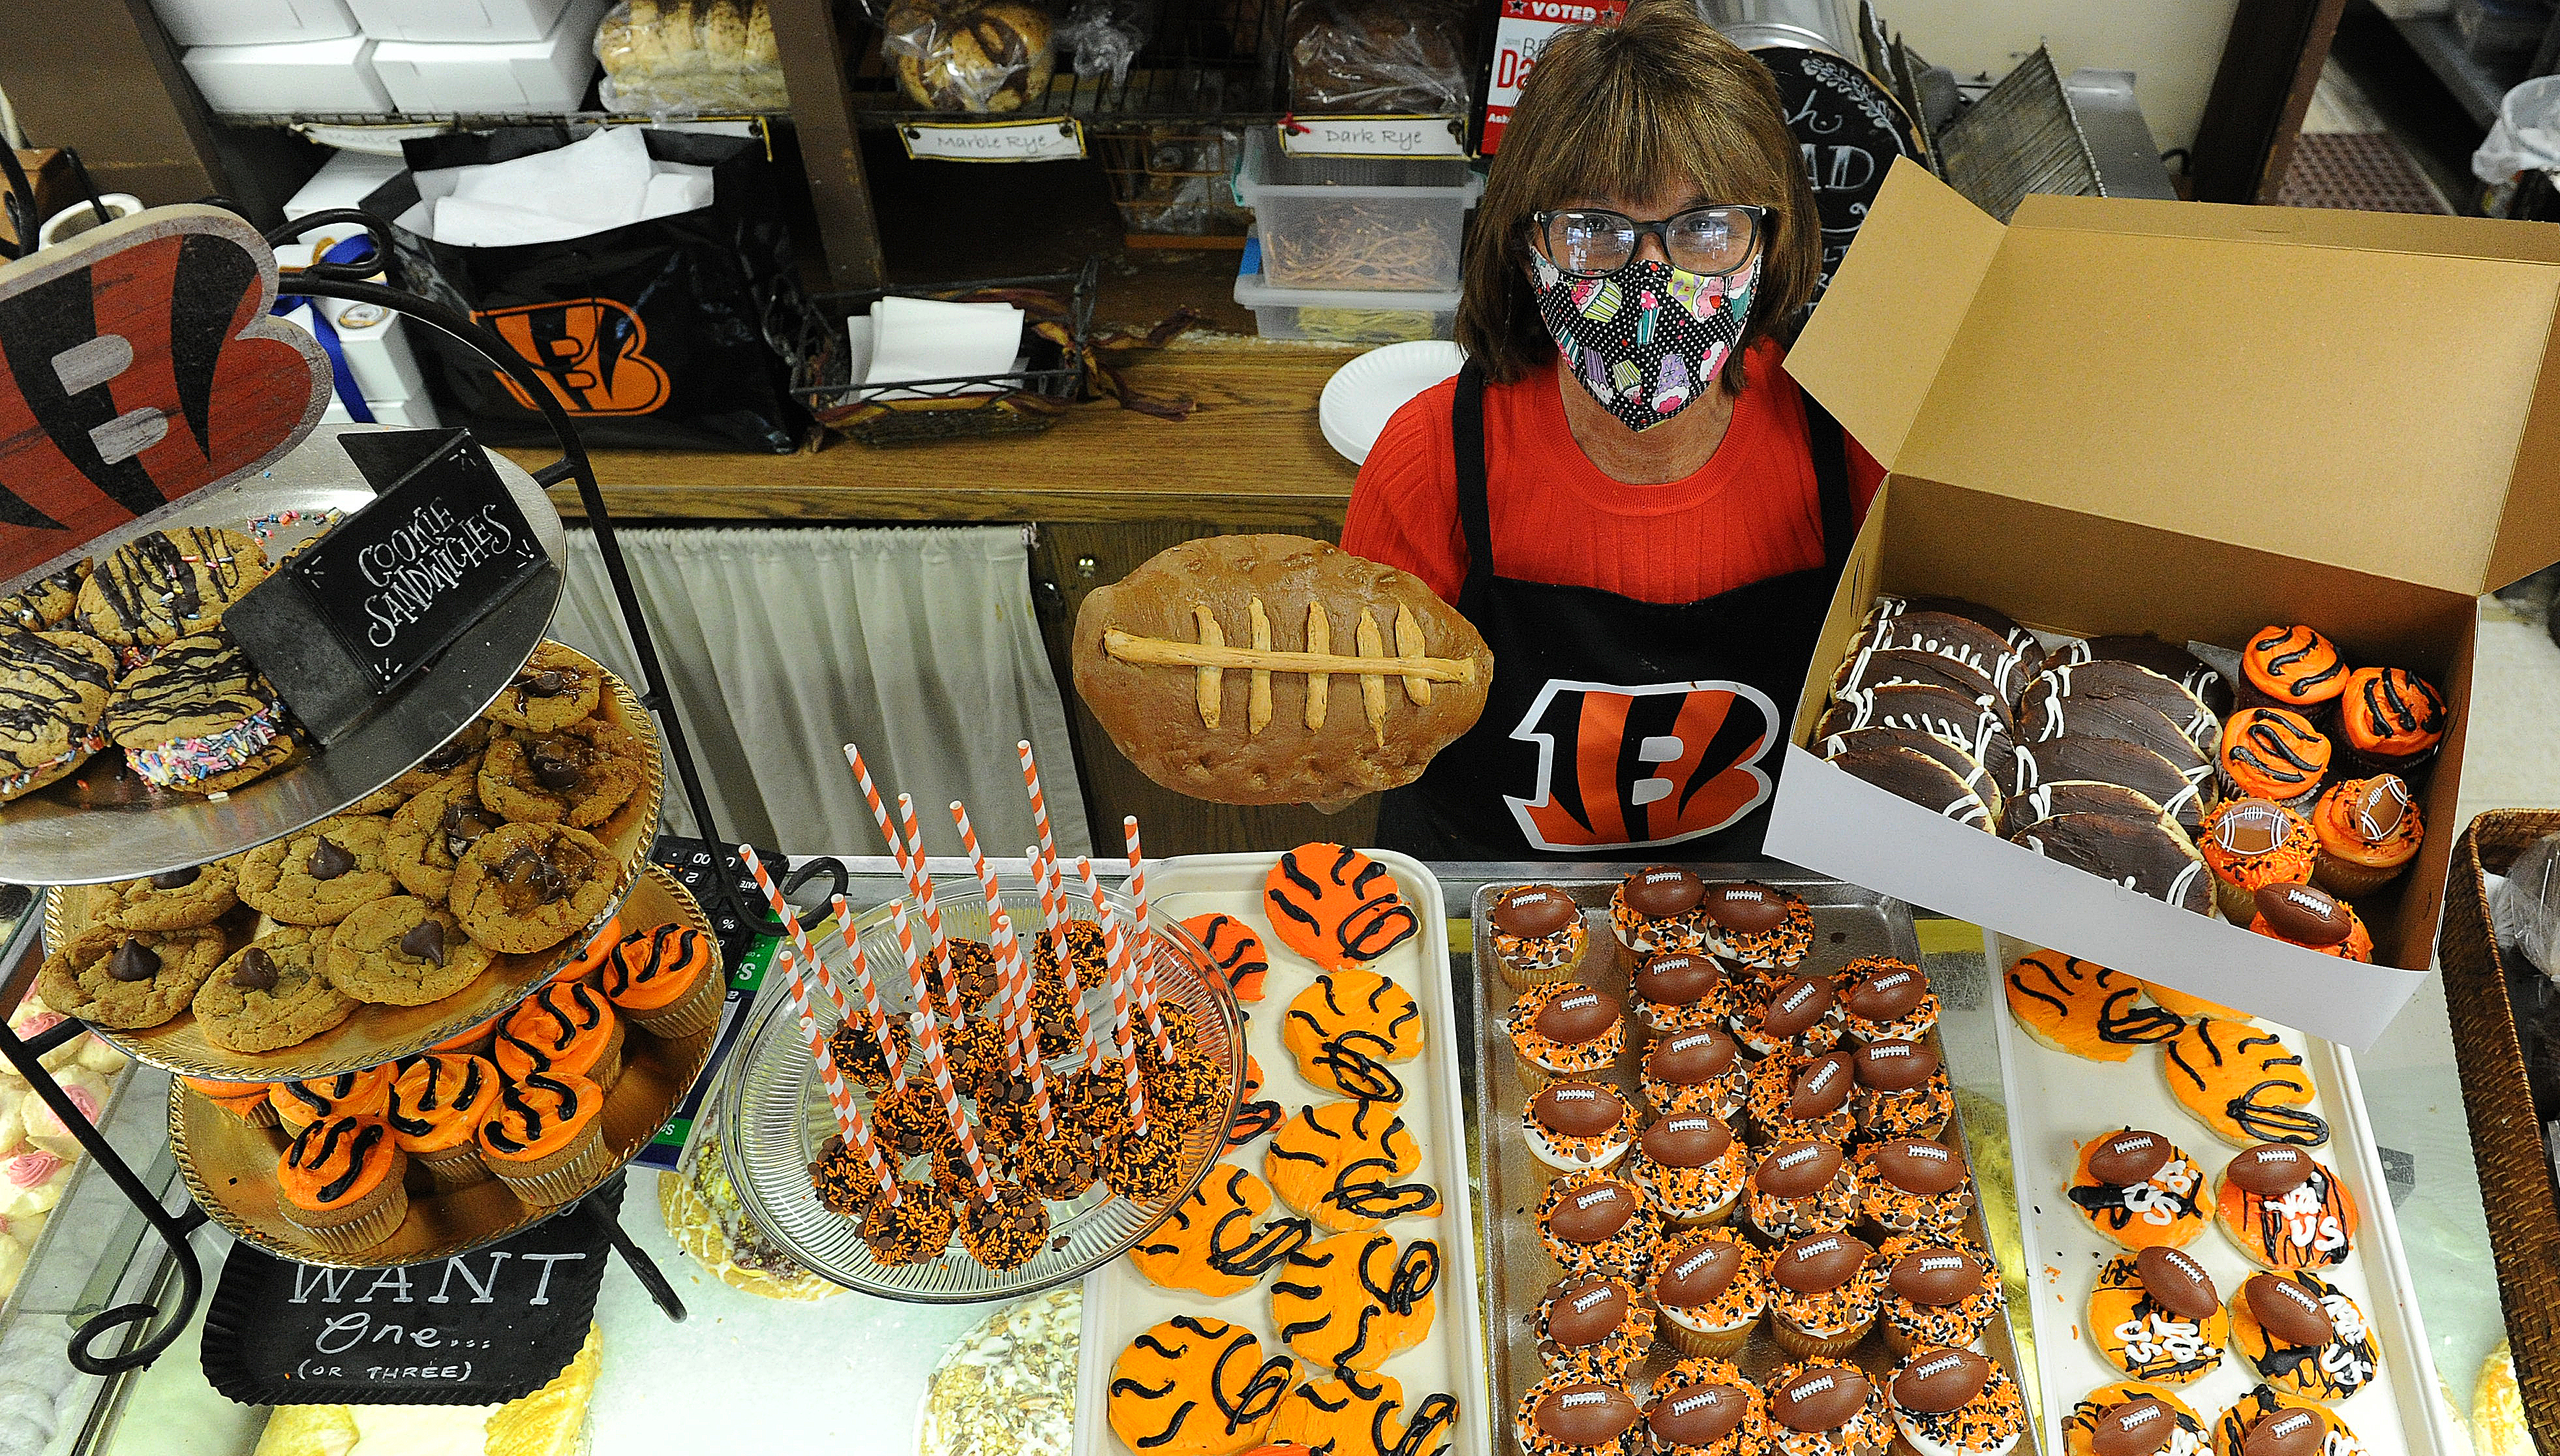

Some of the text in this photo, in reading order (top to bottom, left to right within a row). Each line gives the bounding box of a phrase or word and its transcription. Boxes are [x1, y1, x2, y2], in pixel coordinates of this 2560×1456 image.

[1531, 1, 1597, 22] VOTED
[937, 134, 1046, 154] Marble Rye
[1325, 129, 1424, 152] Dark Rye
[357, 496, 459, 588] COOKIE
[363, 503, 511, 648] SANDWICHES
[739, 880, 758, 892] RATE
[286, 1251, 586, 1307] WANT
[296, 1358, 473, 1383] (OR THREE)
